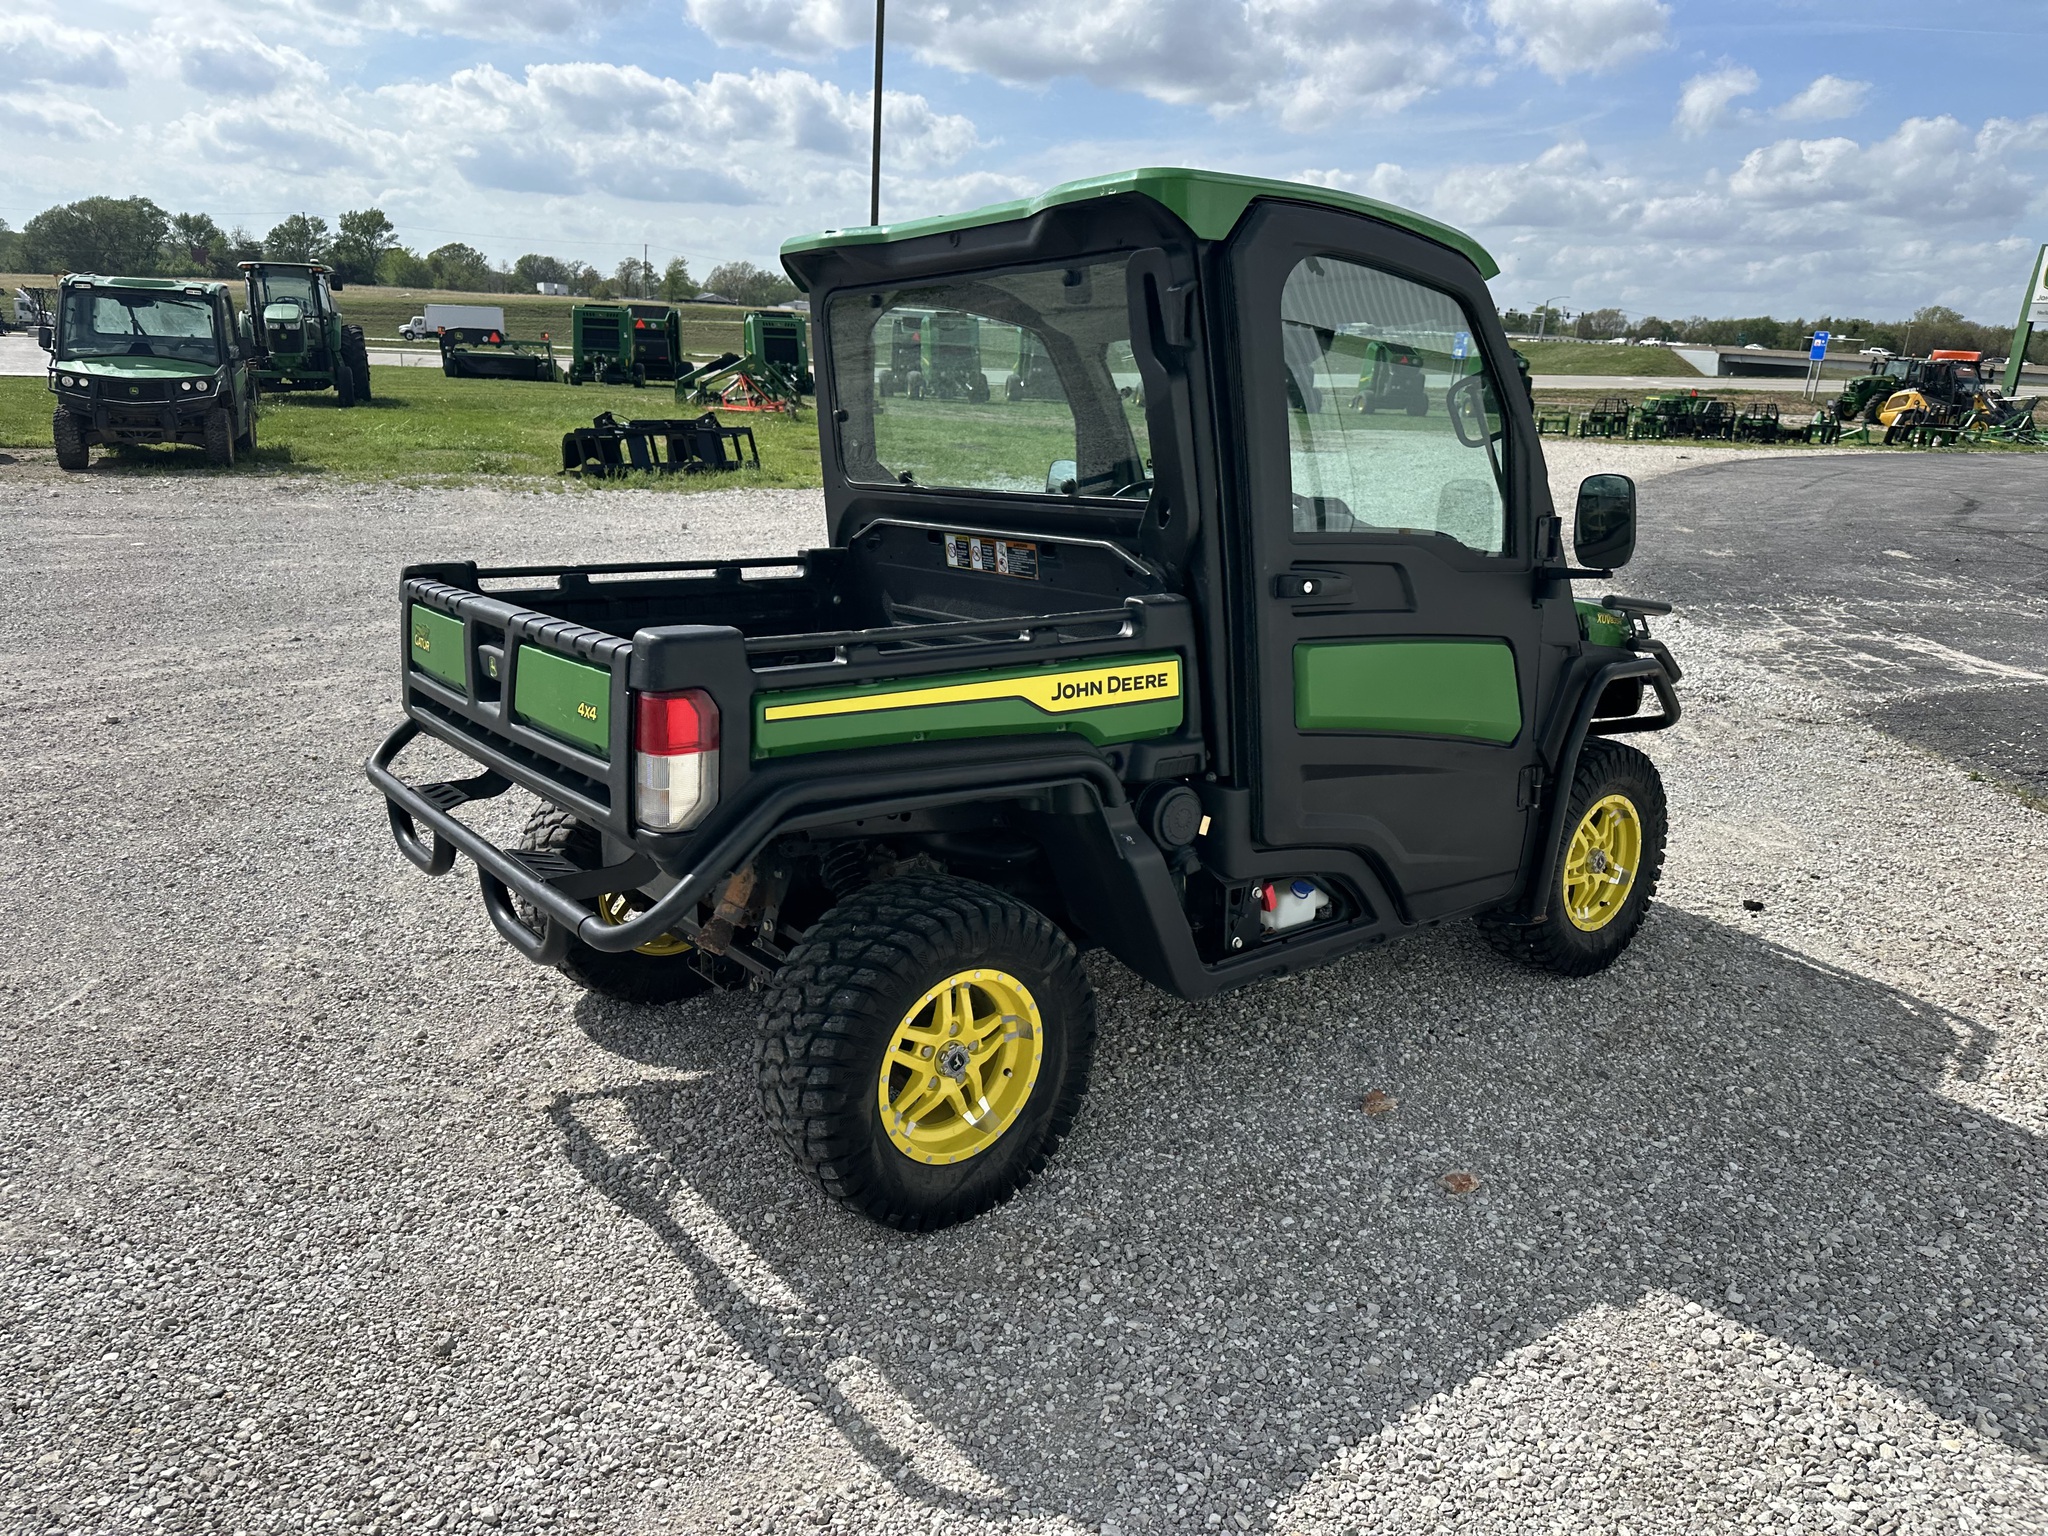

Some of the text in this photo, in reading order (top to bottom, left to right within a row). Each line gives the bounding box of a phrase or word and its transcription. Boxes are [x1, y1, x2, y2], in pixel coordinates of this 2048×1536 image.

[414, 633, 430, 652] GATOR
[1051, 673, 1168, 701] JOHN DEERE
